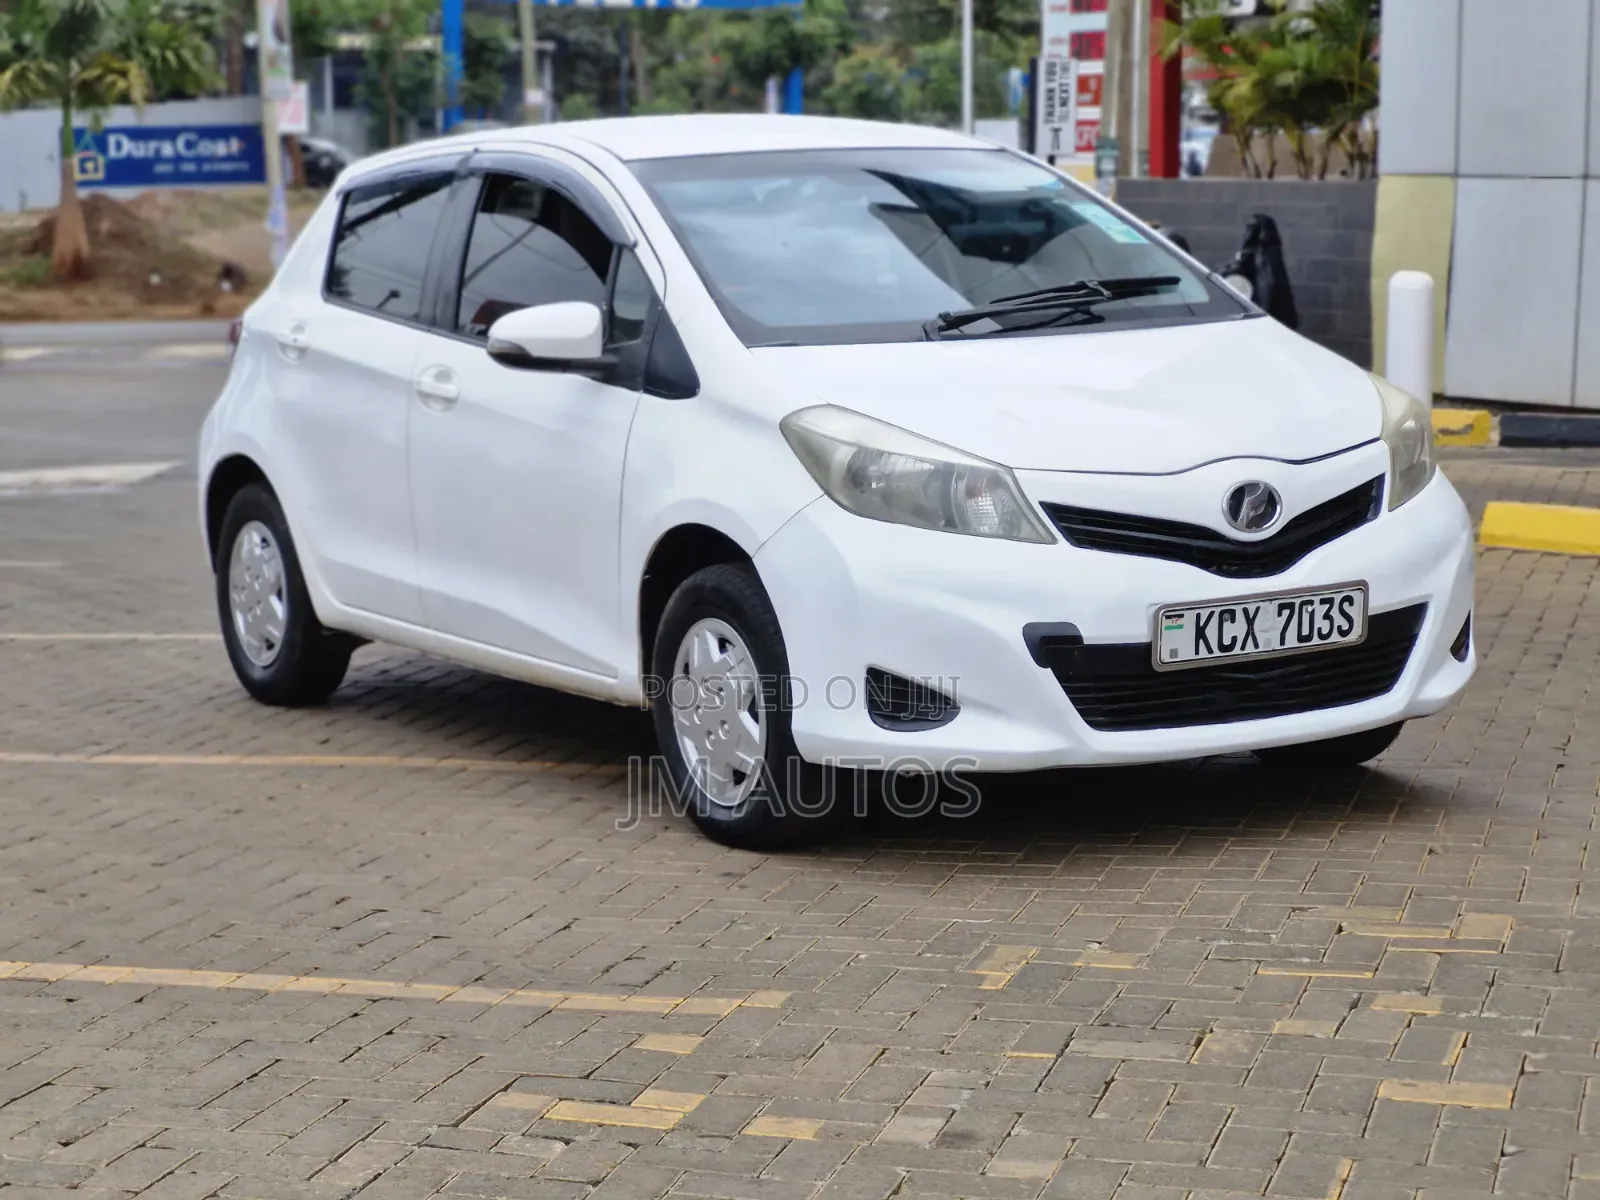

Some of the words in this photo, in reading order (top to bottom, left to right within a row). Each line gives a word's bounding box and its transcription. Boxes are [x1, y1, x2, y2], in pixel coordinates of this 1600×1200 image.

[1045, 61, 1057, 83] YOU
[1044, 87, 1056, 124] THANK
[1058, 82, 1069, 108] NEXT
[107, 132, 243, 159] DuraCoat
[1194, 605, 1260, 655] KCX
[1277, 594, 1355, 646] 703S
